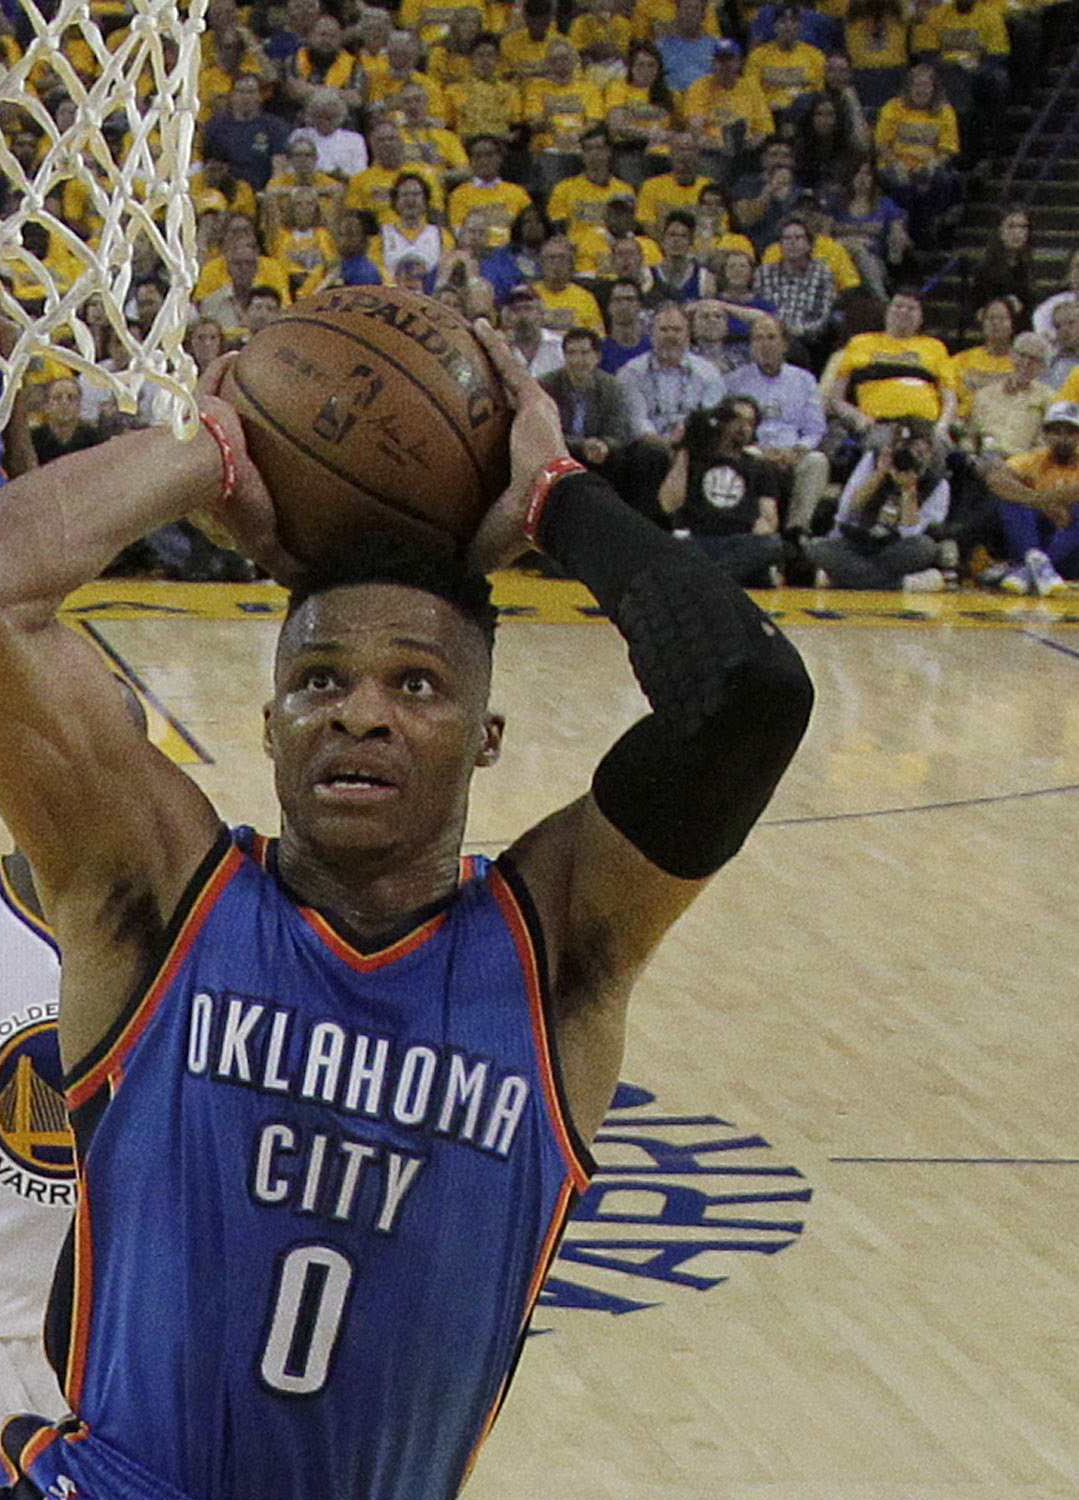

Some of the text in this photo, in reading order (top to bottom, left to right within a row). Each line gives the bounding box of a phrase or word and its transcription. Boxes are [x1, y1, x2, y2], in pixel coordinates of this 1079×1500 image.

[187, 992, 530, 1156] OKLAHOMA
[253, 1122, 425, 1232] CITY
[260, 1245, 353, 1394] 0
